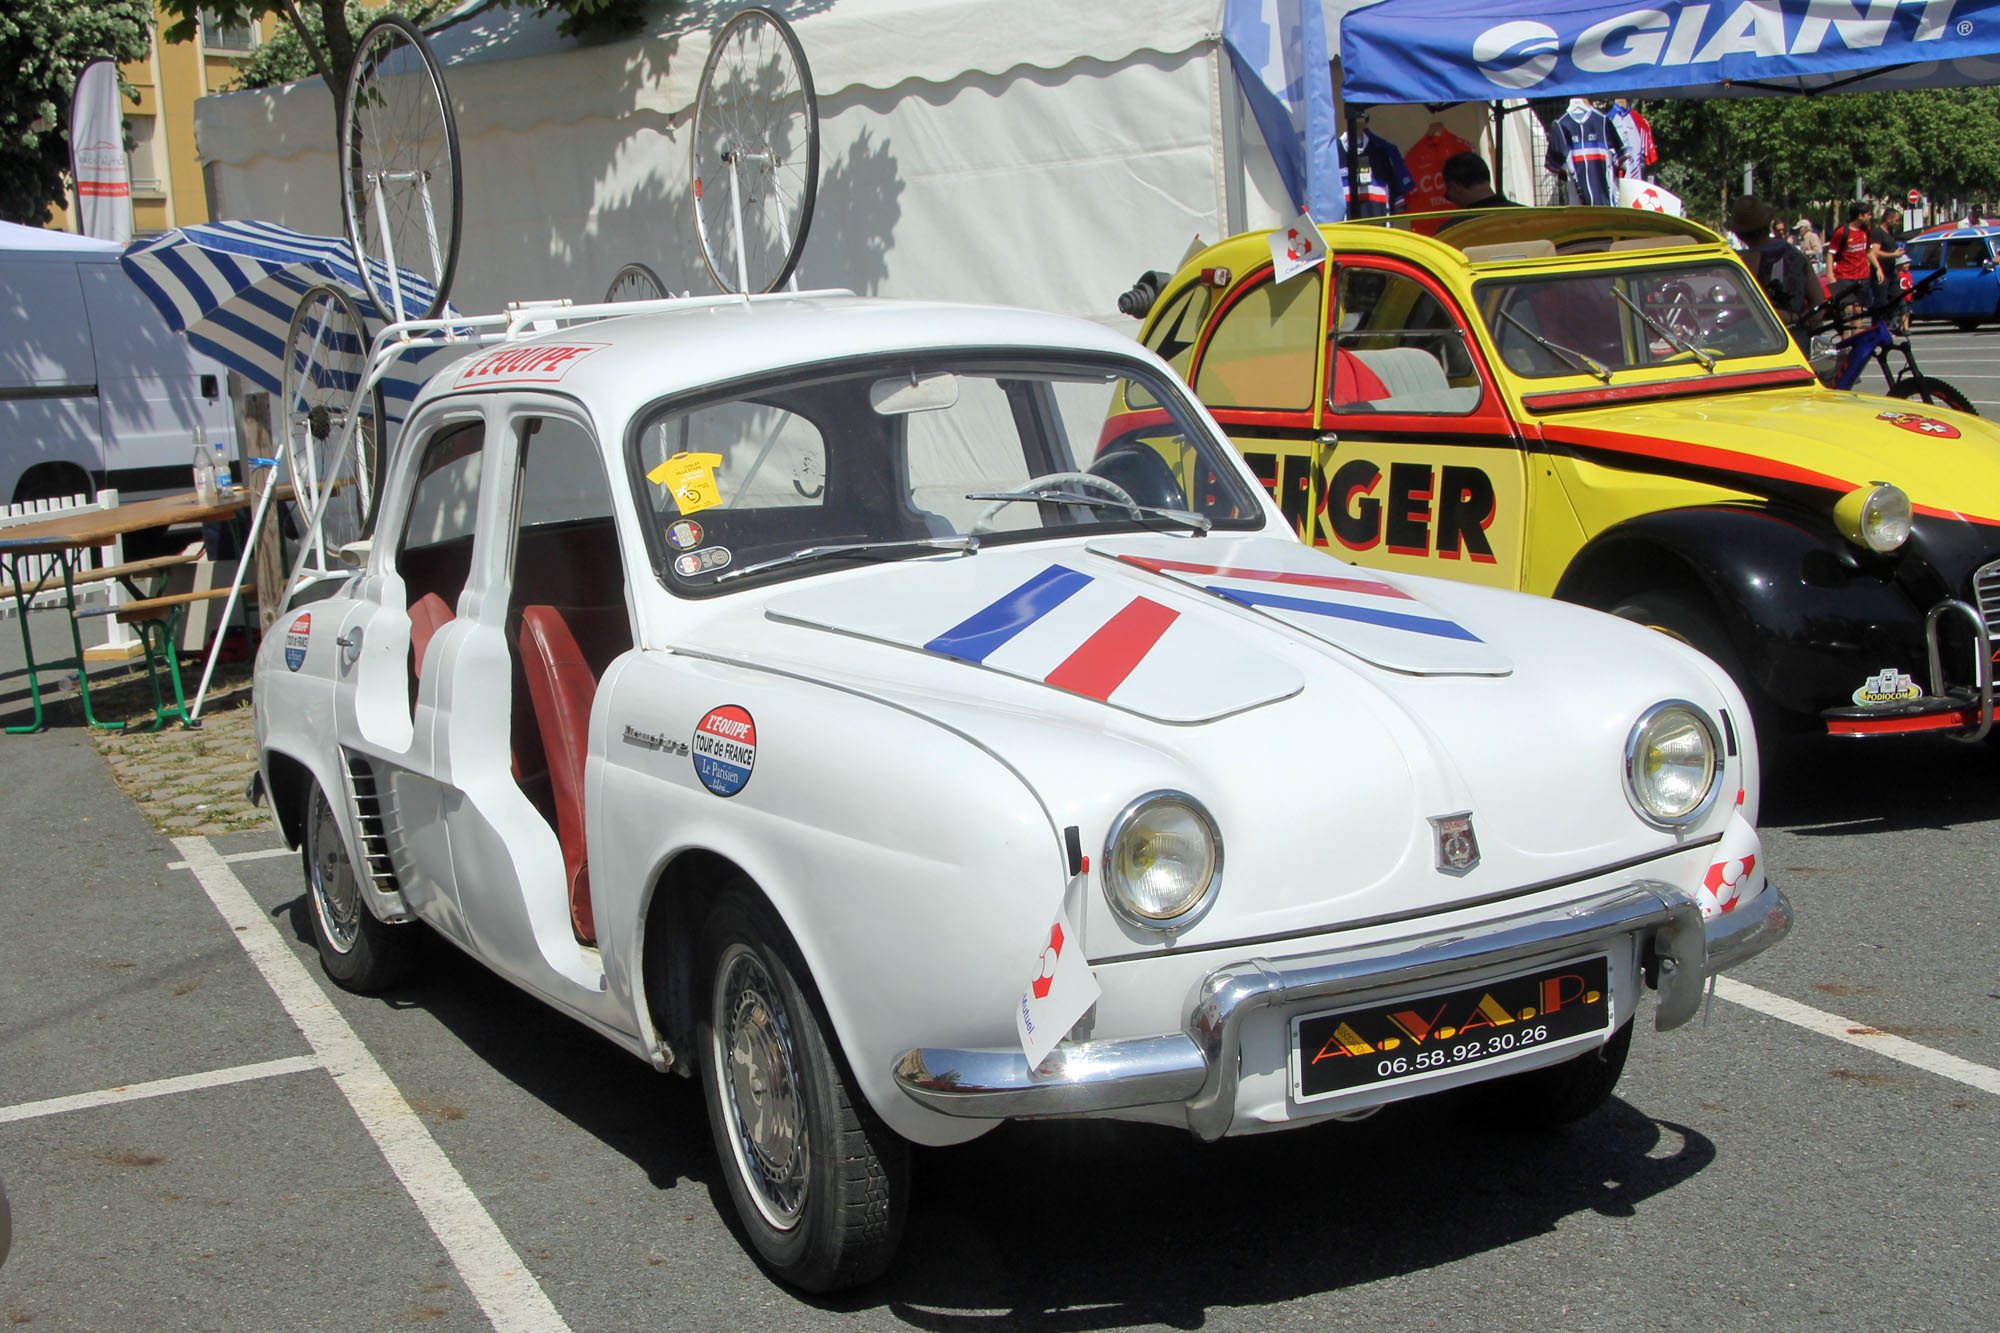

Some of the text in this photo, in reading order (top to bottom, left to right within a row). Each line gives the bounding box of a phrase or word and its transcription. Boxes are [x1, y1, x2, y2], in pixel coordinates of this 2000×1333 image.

[1571, 0, 1957, 73] GIANT
[1866, 692, 1908, 701] PODIOCOM
[696, 734, 753, 766] TOUR de FRANCE
[702, 758, 739, 784] Le Parisien
[1377, 1025, 1547, 1077] 06.58.92.30.26
